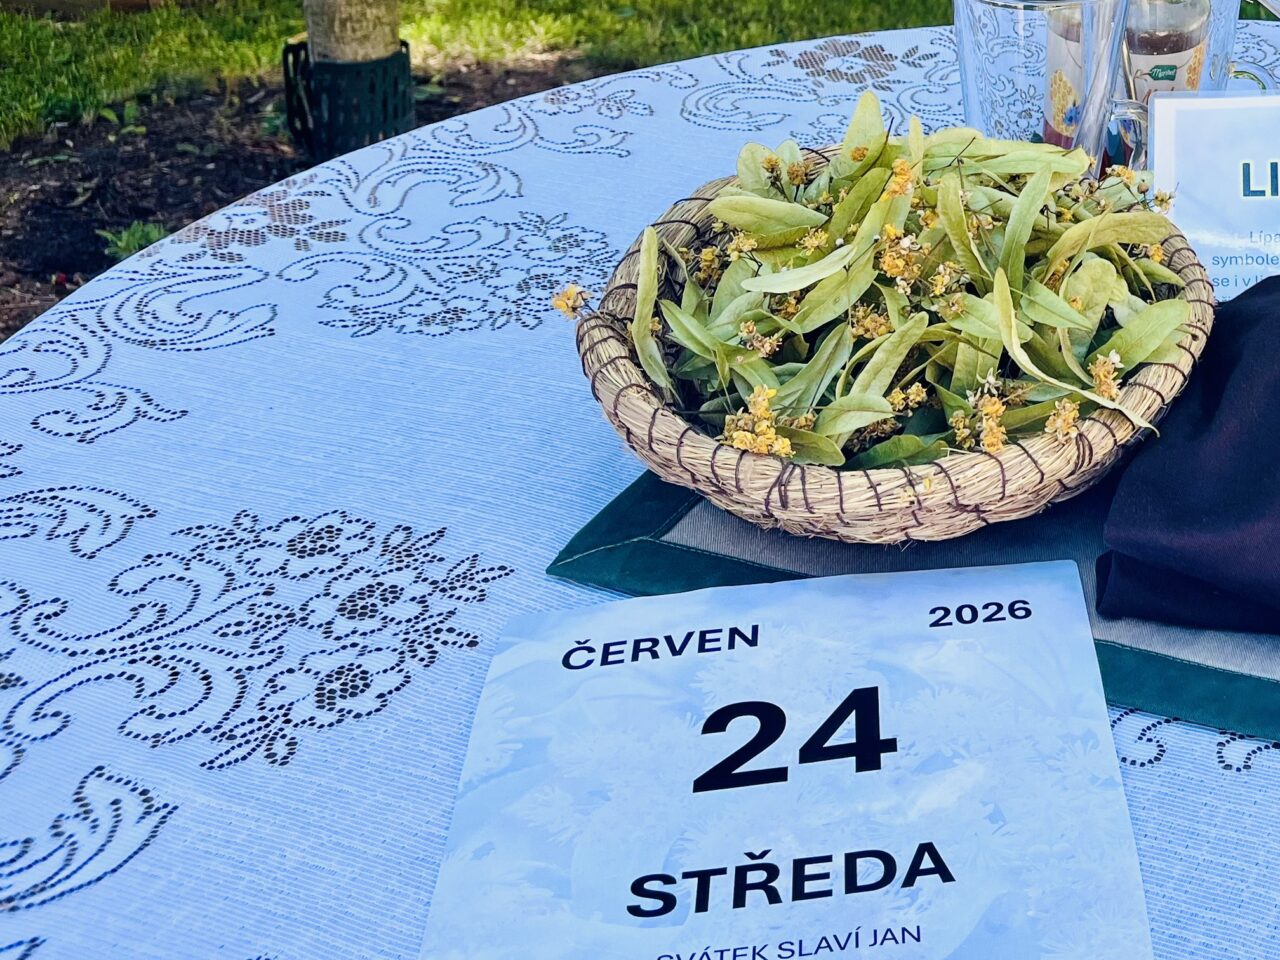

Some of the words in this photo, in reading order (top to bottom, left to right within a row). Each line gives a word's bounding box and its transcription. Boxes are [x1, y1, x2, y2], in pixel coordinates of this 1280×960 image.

[1212, 277, 1230, 287] se
[1242, 277, 1251, 287] v
[561, 624, 759, 670] ČERVEN
[928, 599, 1033, 628] 2026
[692, 686, 898, 793] 24
[626, 841, 955, 918] STŘEDA
[777, 926, 862, 959] SLAVÍ
[868, 925, 921, 947] JAN
